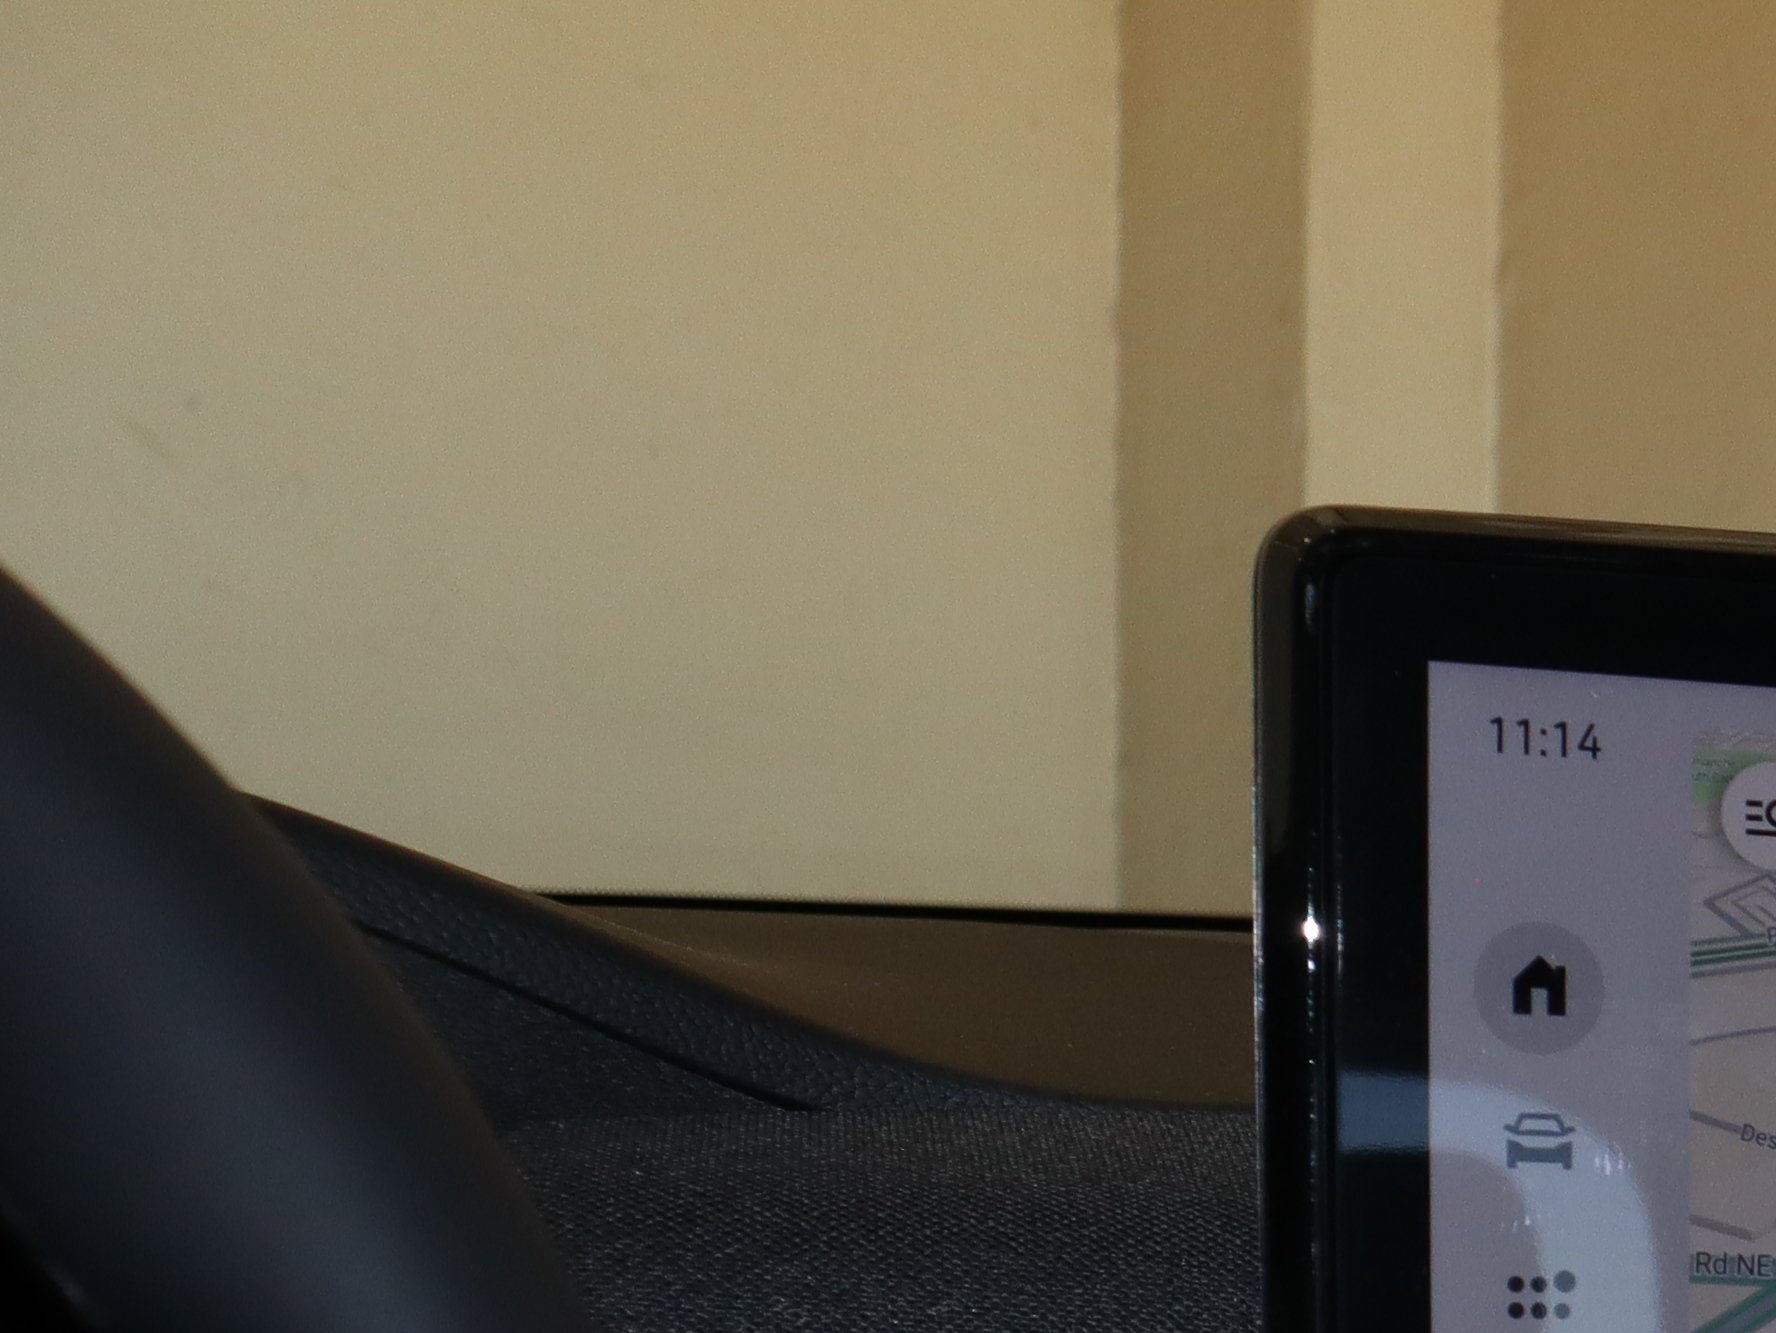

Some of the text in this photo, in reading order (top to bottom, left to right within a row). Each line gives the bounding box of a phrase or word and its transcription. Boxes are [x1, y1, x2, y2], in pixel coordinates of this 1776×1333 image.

[1490, 716, 1602, 760] 11:14
[1694, 1252, 1774, 1278] Rd NE
